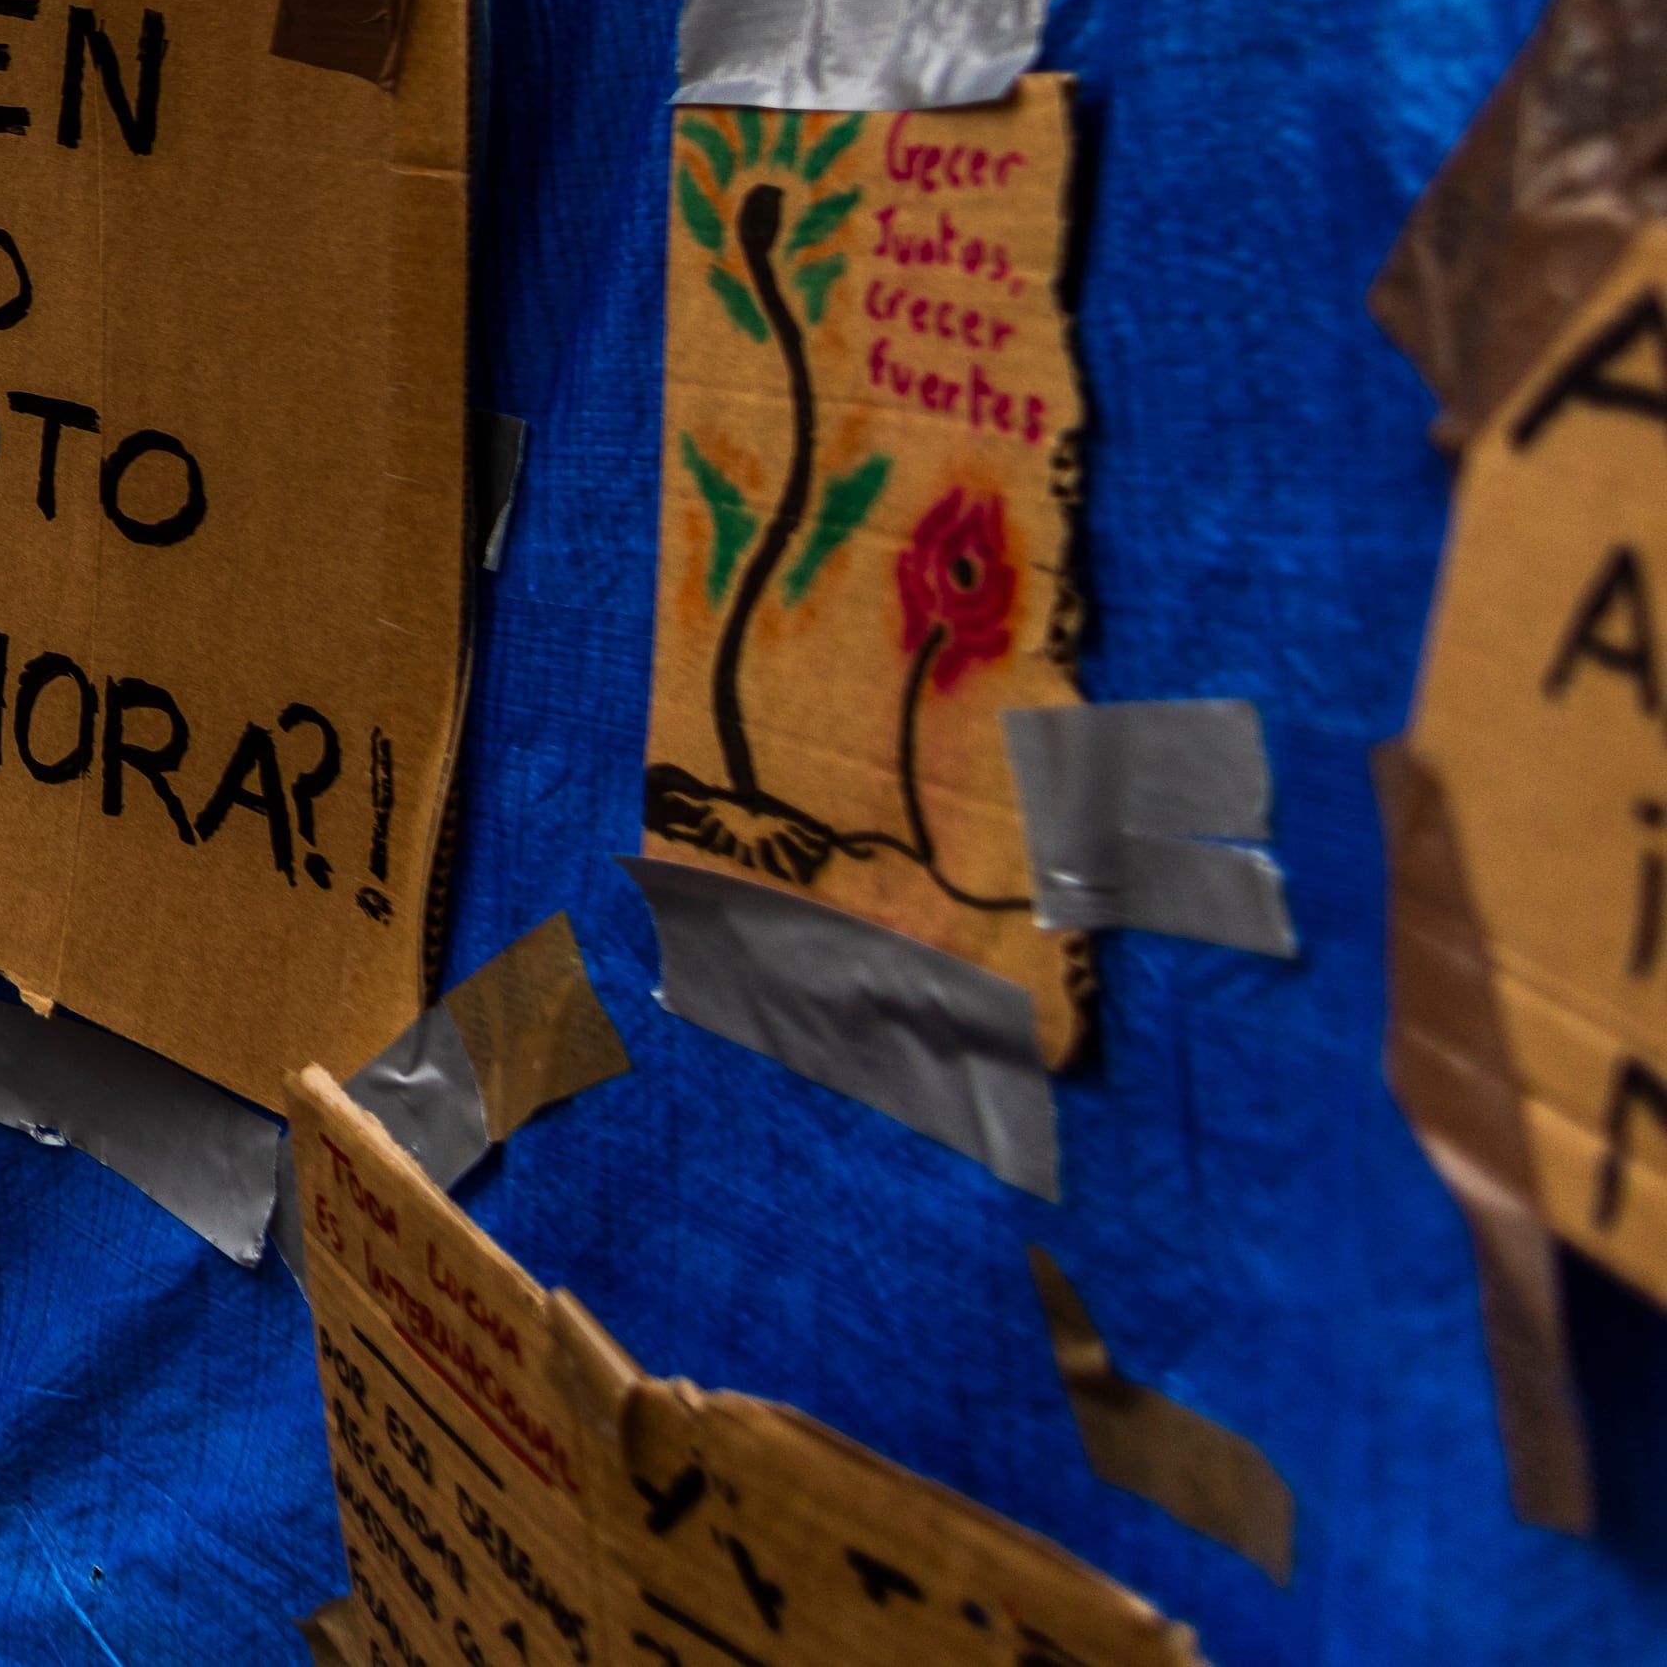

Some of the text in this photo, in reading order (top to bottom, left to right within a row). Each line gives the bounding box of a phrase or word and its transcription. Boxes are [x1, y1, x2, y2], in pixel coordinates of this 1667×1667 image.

[867, 277, 1017, 356] crecer
[869, 337, 1049, 448] fuertes
[314, 1193, 346, 1254] ES
[319, 1129, 403, 1250] TODA
[426, 1241, 524, 1367] LUCHA
[319, 1323, 368, 1405] POR
